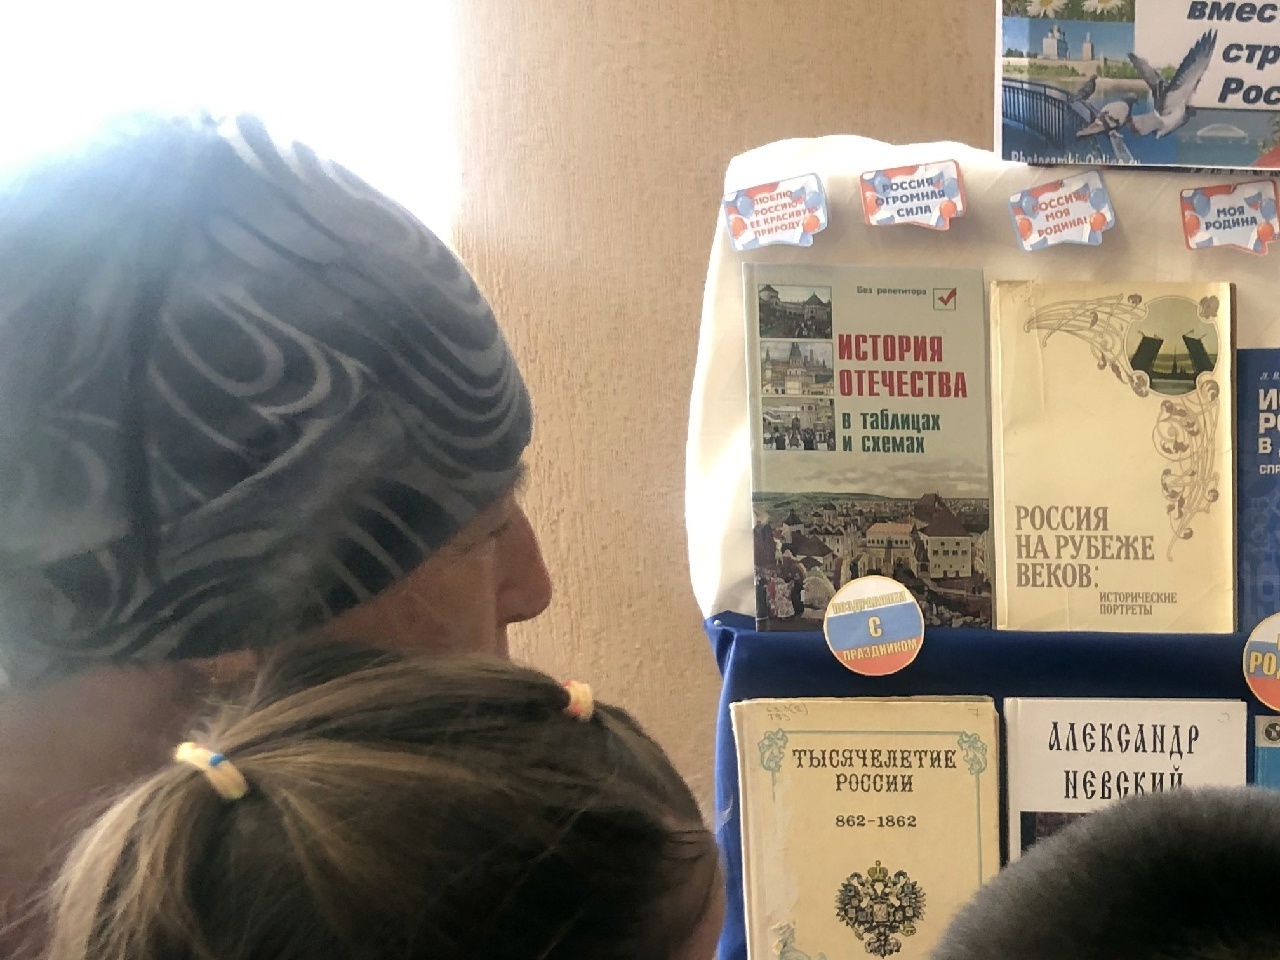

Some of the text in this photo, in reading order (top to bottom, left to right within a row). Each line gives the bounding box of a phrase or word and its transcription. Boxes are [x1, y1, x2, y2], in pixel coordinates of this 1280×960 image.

[882, 177, 934, 192] РОССИЯ
[753, 190, 793, 205] ЛЮБЛЮ
[875, 189, 945, 206] ОГРОМНАЯ
[1031, 191, 1080, 212] РОССИЯ
[754, 201, 798, 217] РОССИЮ
[763, 206, 819, 225] КРАСИВУЮ
[896, 205, 932, 217] СИЛА
[1045, 207, 1071, 222] МОЯ
[1216, 206, 1245, 218] МОЯ
[1037, 216, 1088, 237] РОДИНА!
[1205, 216, 1258, 230] РОДИНА
[857, 286, 927, 296] Без репетитора
[838, 334, 943, 362] ИСТОРИЯ
[839, 370, 968, 398] ОТЕЧЕСТВА
[842, 409, 941, 433] в таблицах
[861, 435, 925, 453] схемах
[1258, 437, 1273, 454] В
[1015, 505, 1109, 531] РОССИЯ
[1015, 534, 1155, 560] НА РУБЕЖЕ
[1016, 563, 1099, 588] ВЕКОВ:
[1099, 592, 1177, 604] ИСТОРИЧЕСКИЕ
[1100, 604, 1153, 615] ПОРТРЕТЫ
[868, 616, 883, 638] С
[843, 638, 918, 660] ПРАЗДНИКОМ
[1049, 721, 1200, 760] АЛЕКСАНДР
[792, 749, 957, 769] ТЫСЯЧЕЛЕТИЕ
[835, 773, 914, 793] РОССИИ
[1064, 765, 1184, 799] НЕВСКИЙ
